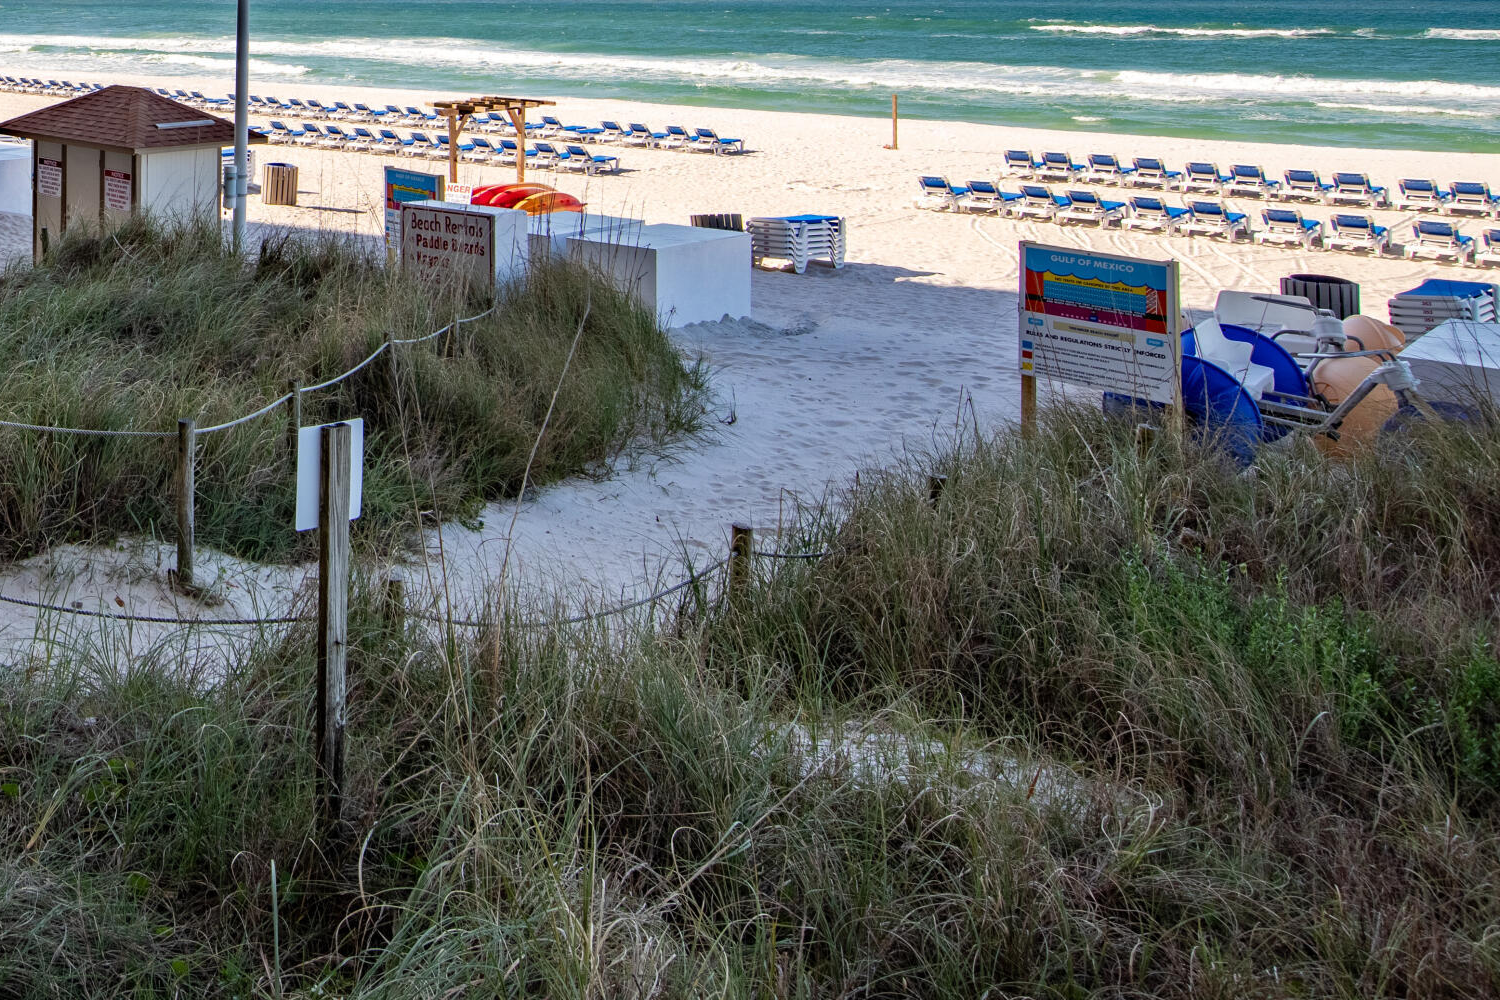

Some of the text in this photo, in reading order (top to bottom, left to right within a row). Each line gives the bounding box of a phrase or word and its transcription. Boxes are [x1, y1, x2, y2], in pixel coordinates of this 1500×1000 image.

[446, 184, 471, 194] NGER
[411, 212, 441, 233] Beach
[445, 215, 483, 238] Rentals
[416, 233, 449, 251] Paddle
[1050, 254, 1135, 273] GULF OF MEXICO
[1025, 329, 1044, 338] RULES
[1045, 333, 1059, 341] AND
[1060, 335, 1103, 348] REGULATIONS
[1133, 349, 1166, 360] NFORCED
